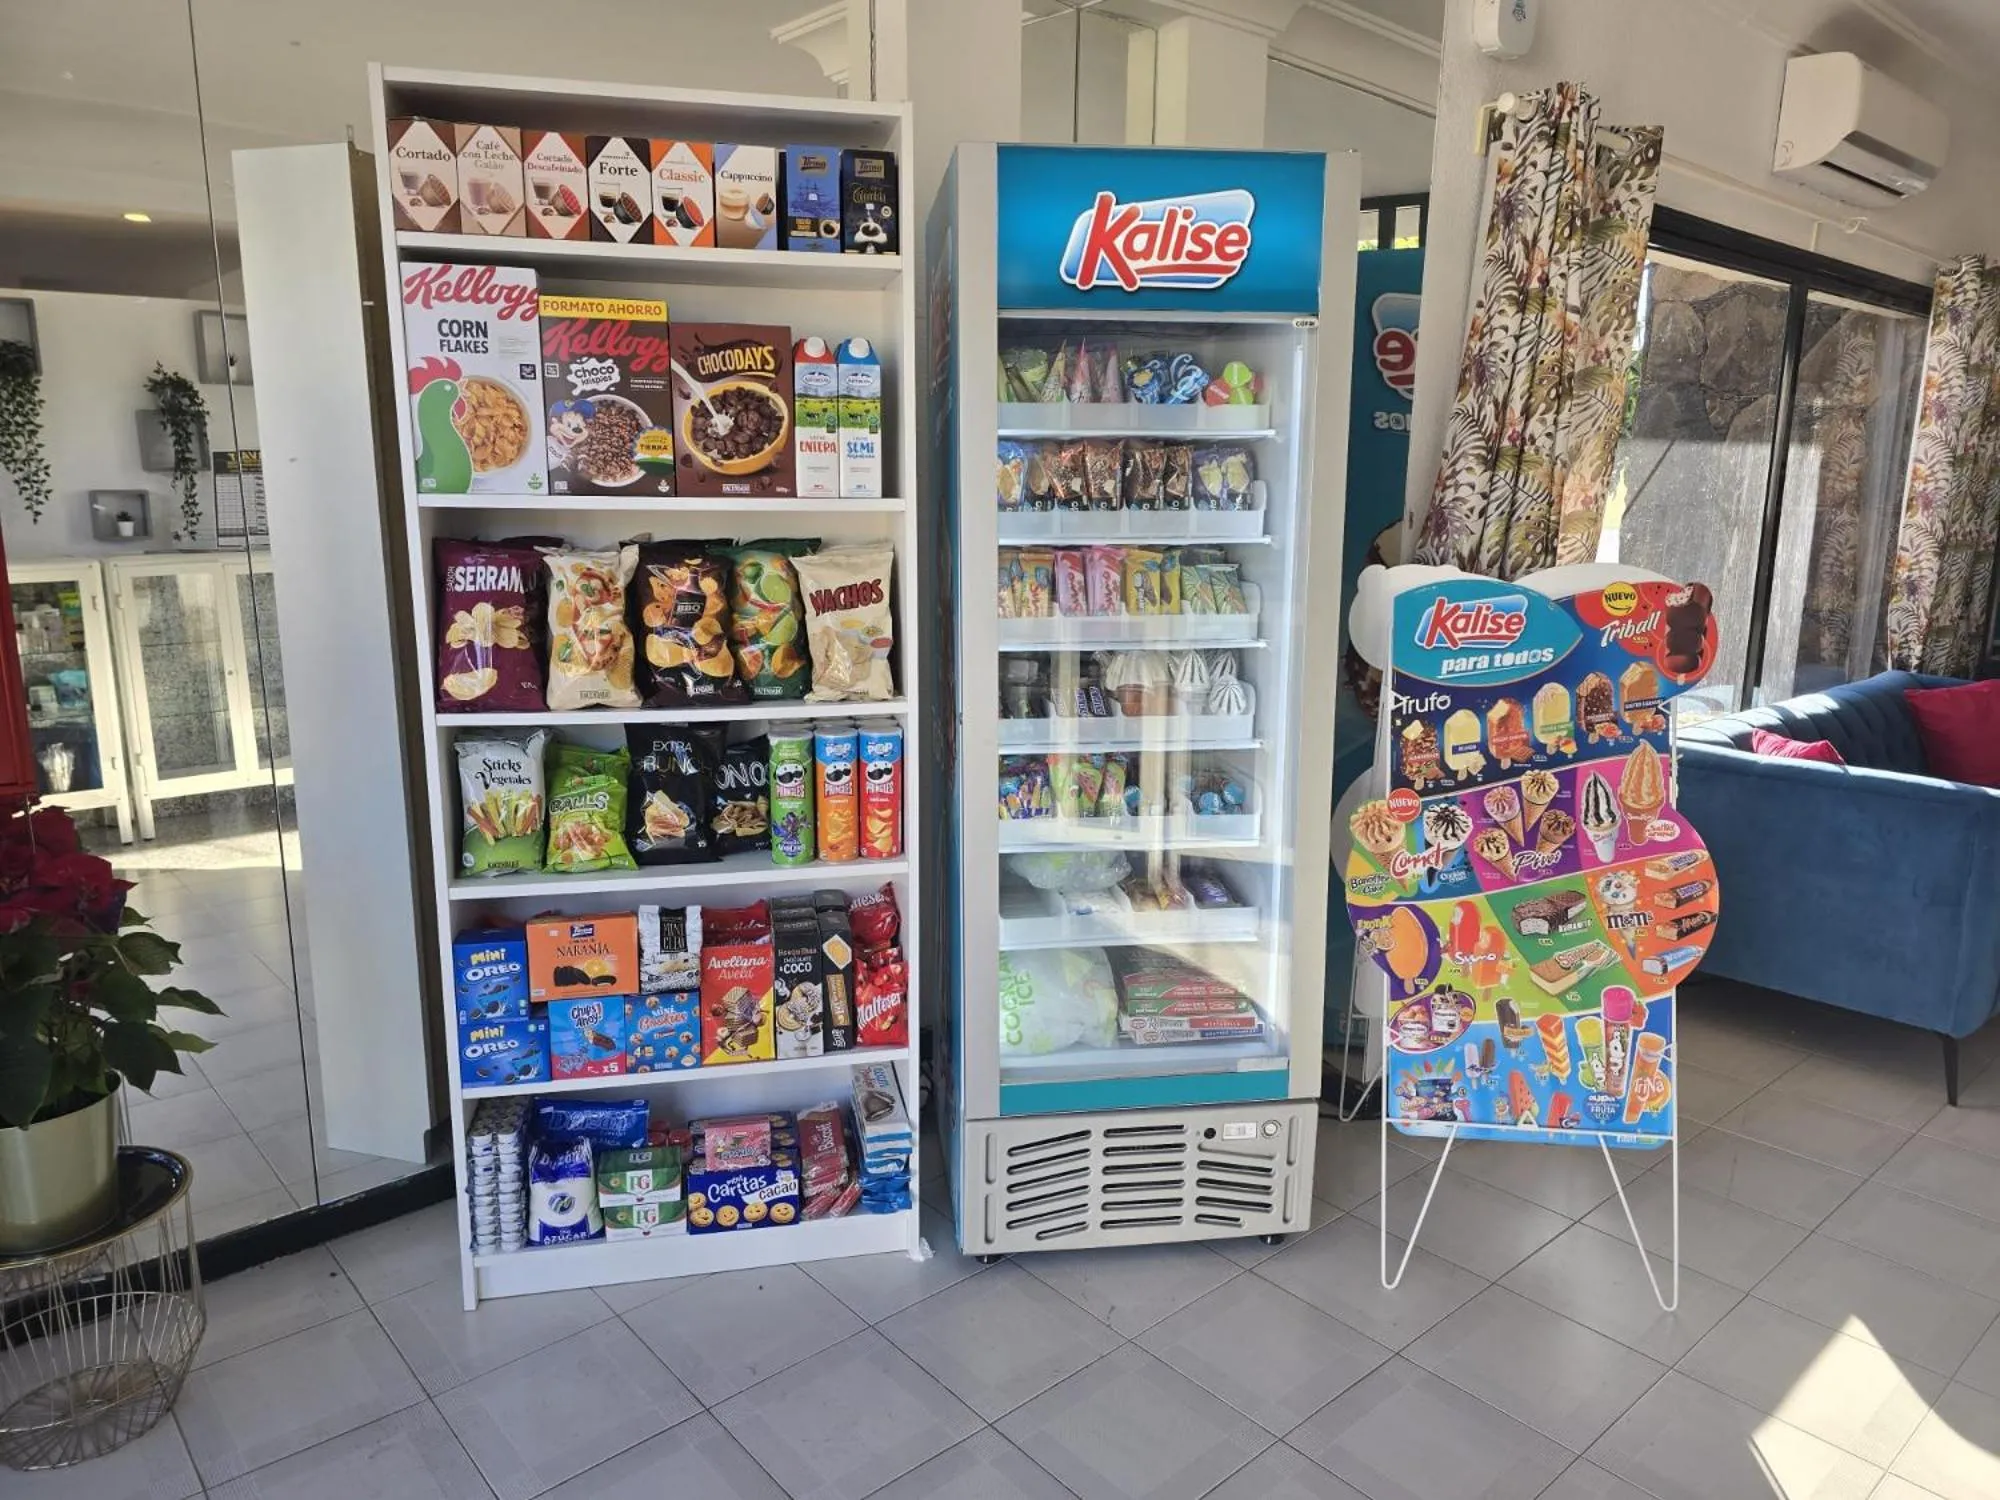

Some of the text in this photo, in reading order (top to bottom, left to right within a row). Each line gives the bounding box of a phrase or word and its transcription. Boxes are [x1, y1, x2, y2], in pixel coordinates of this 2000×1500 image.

[475, 139, 499, 151] Café
[396, 147, 451, 162] Cortado
[462, 150, 515, 162] con Leche
[599, 161, 638, 176] Forte
[659, 168, 705, 184] Classic
[720, 170, 773, 183] Cappuccino
[1077, 192, 1251, 291] Kalise
[542, 302, 663, 317] FORMATO AHORRO
[437, 318, 489, 339] CORN
[438, 339, 489, 354] FLAKES
[697, 345, 775, 376] CHOCODAYS
[574, 363, 615, 380] choco
[808, 578, 885, 617] NACHOS
[1604, 590, 1637, 603] NUEVO
[1424, 597, 1527, 650] Kalise
[1599, 611, 1660, 648] Triball
[1440, 647, 1554, 675] para todos
[652, 740, 693, 753] EXTRA
[481, 757, 522, 773] Sticks
[475, 771, 532, 790] Vegetales
[549, 791, 609, 815] BALLS
[1388, 798, 1419, 809] NUEVO
[707, 955, 767, 970] Avellana
[783, 962, 813, 975] COCO
[465, 962, 521, 981] OREO
[465, 1039, 519, 1058] OREO
[602, 1062, 620, 1074] x5
[758, 1180, 798, 1201] cacao
